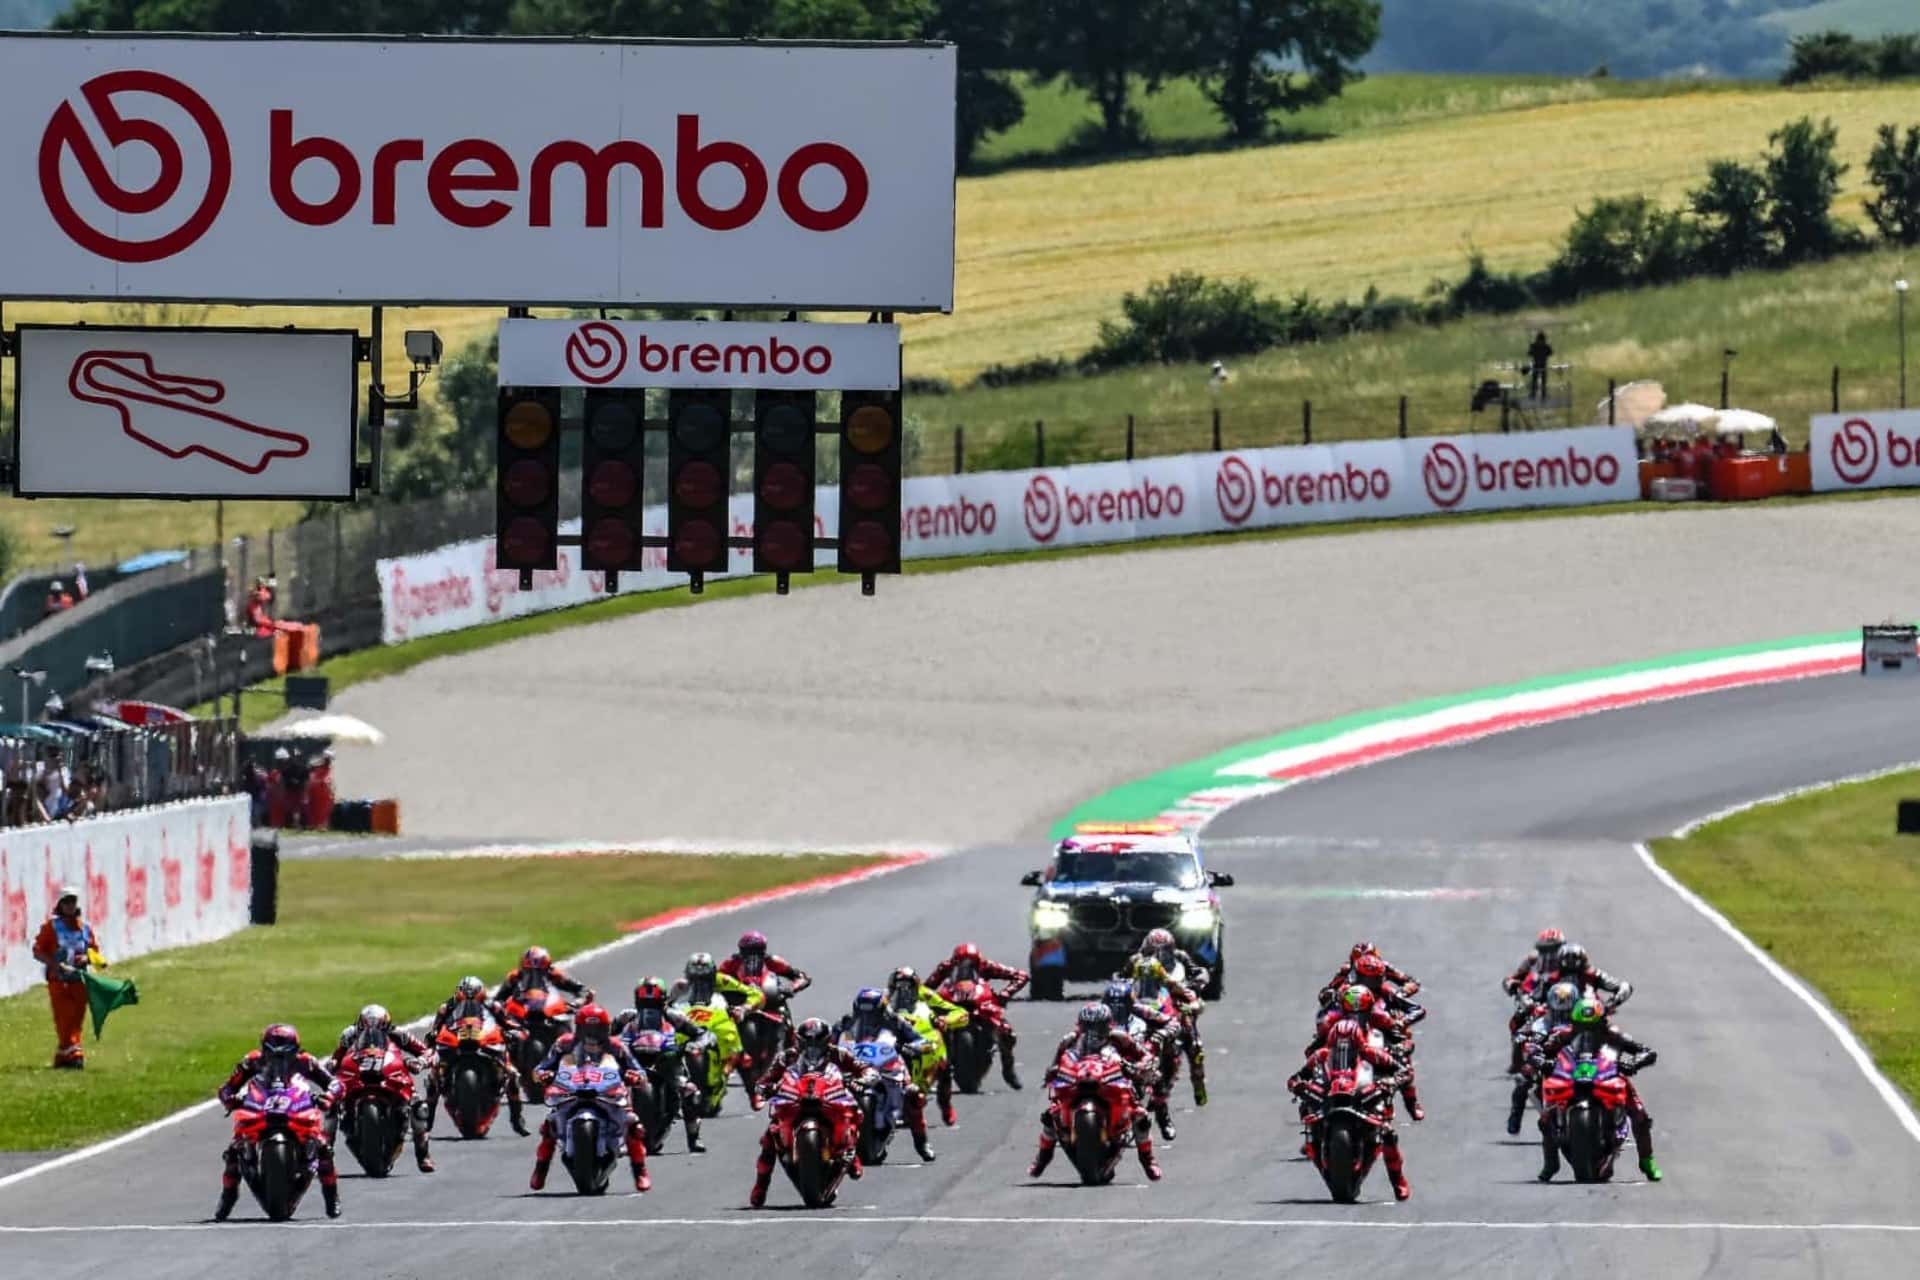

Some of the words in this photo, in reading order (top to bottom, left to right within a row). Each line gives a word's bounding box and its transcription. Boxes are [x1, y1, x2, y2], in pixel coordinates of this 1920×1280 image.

[270, 109, 869, 232] brembo
[639, 334, 832, 374] brembo
[1261, 462, 1390, 507] brembo
[1473, 446, 1620, 492] brembo
[901, 496, 996, 540] rembo
[1064, 476, 1184, 526] brembo
[1077, 1060, 1103, 1077] 23
